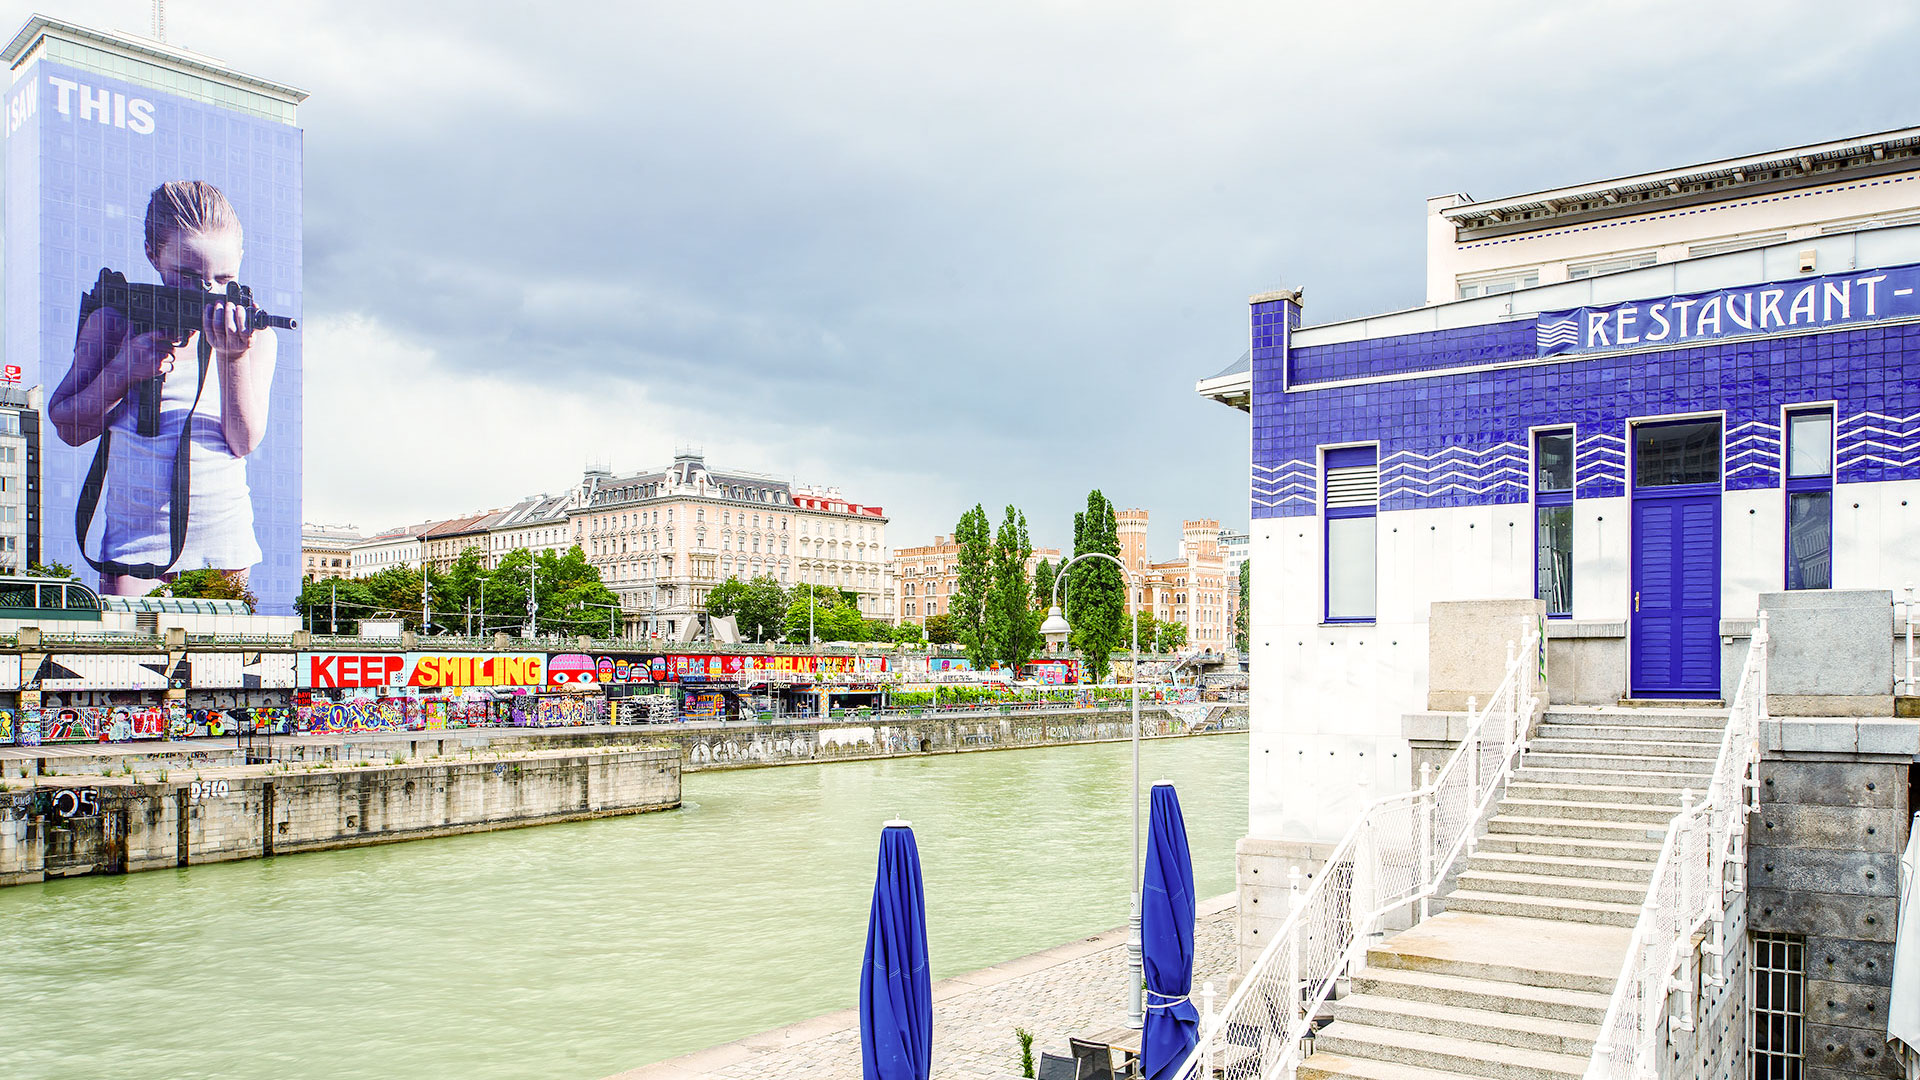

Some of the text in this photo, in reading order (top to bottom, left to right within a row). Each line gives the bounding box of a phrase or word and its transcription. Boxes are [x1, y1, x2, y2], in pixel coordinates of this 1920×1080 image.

[5, 76, 156, 138] I SAW THIS
[311, 656, 541, 688] KEEP SMILING
[774, 657, 811, 673] RELAX
